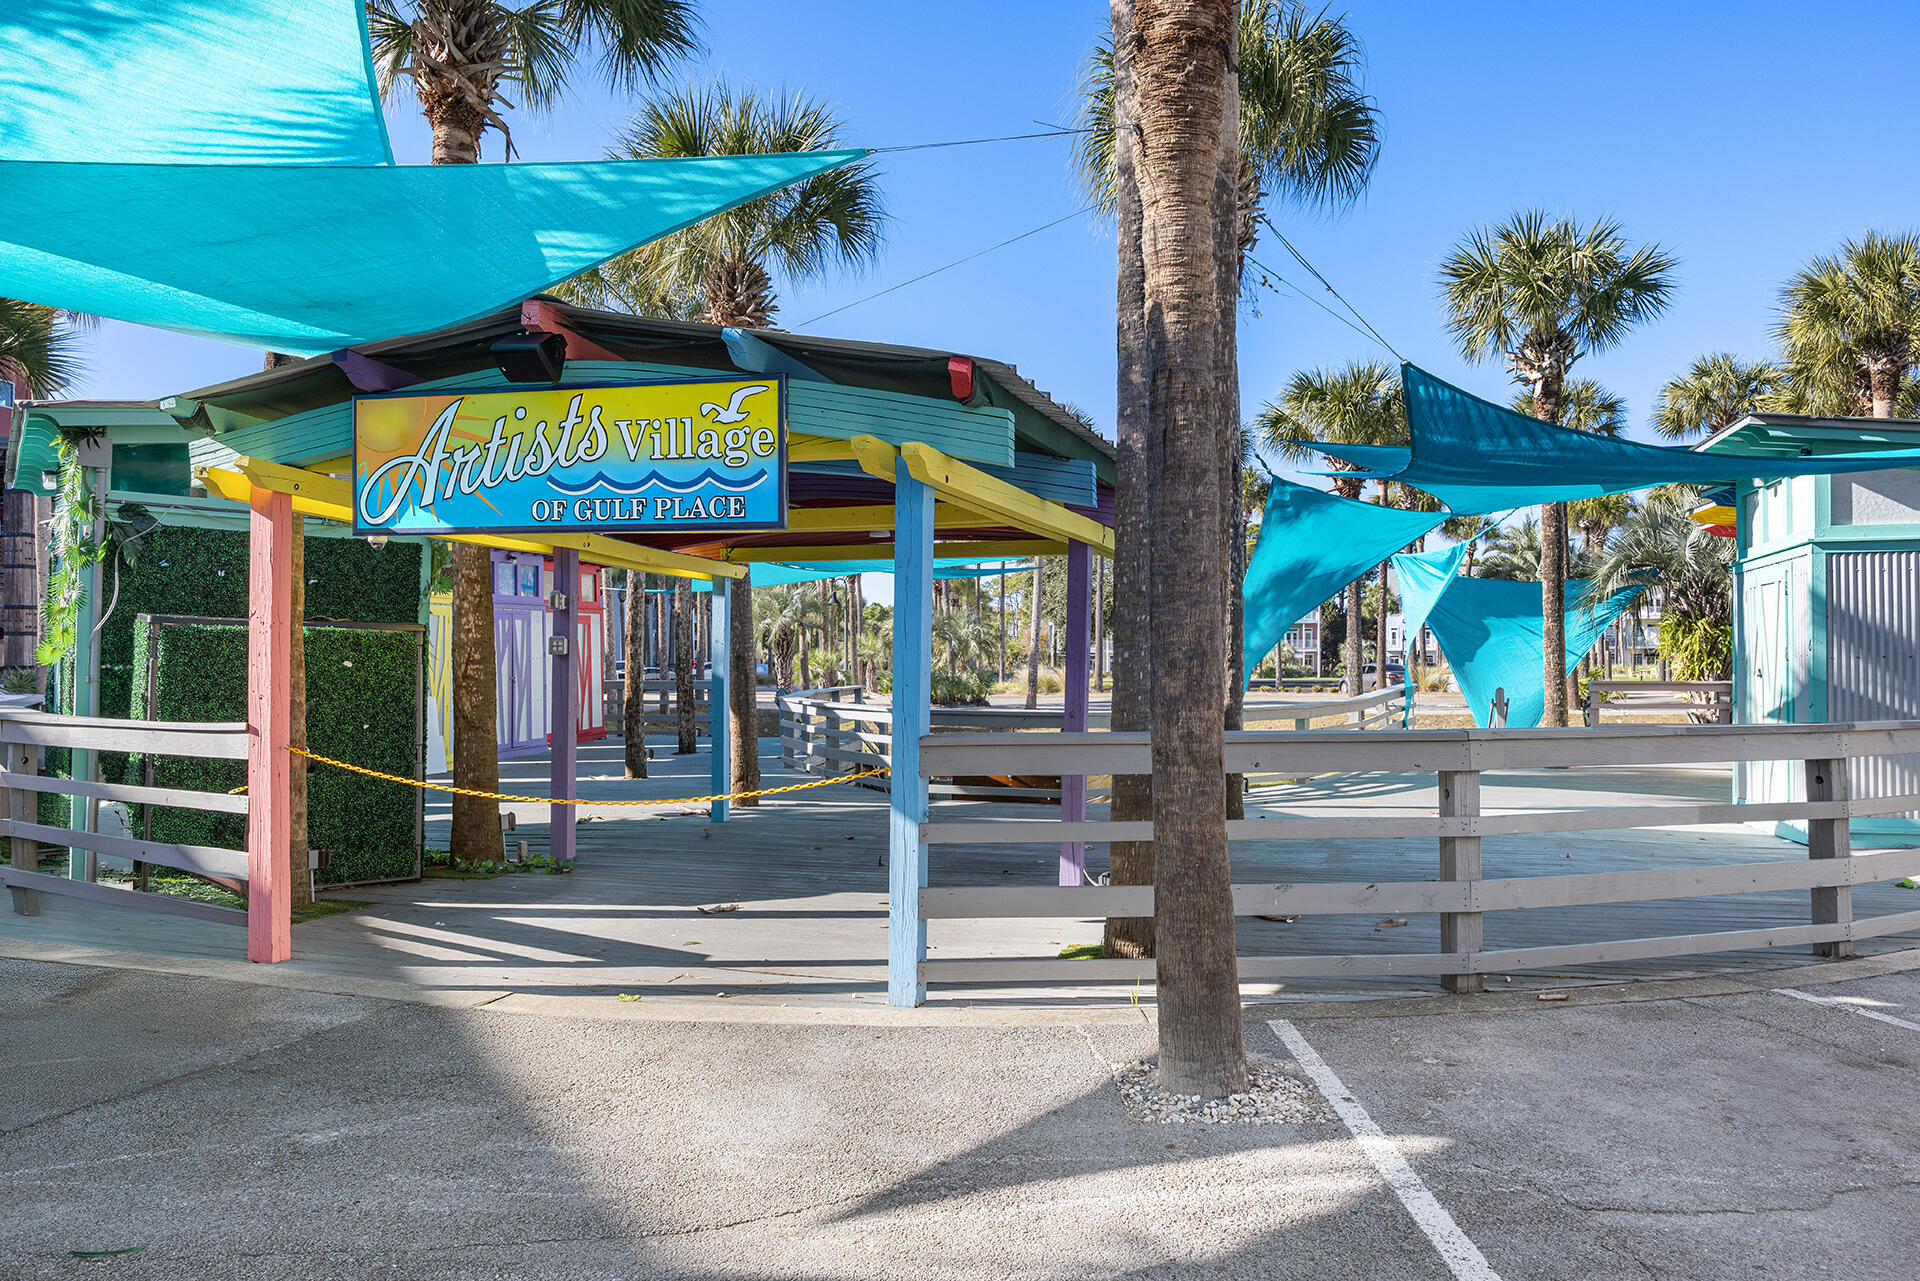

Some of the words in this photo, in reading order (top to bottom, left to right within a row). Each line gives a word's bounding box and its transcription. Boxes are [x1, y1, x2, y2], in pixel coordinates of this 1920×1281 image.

[359, 394, 609, 526] Artists
[615, 416, 777, 468] Village
[531, 499, 568, 521] OF
[573, 498, 647, 521] GULF
[655, 496, 746, 519] PLACE
